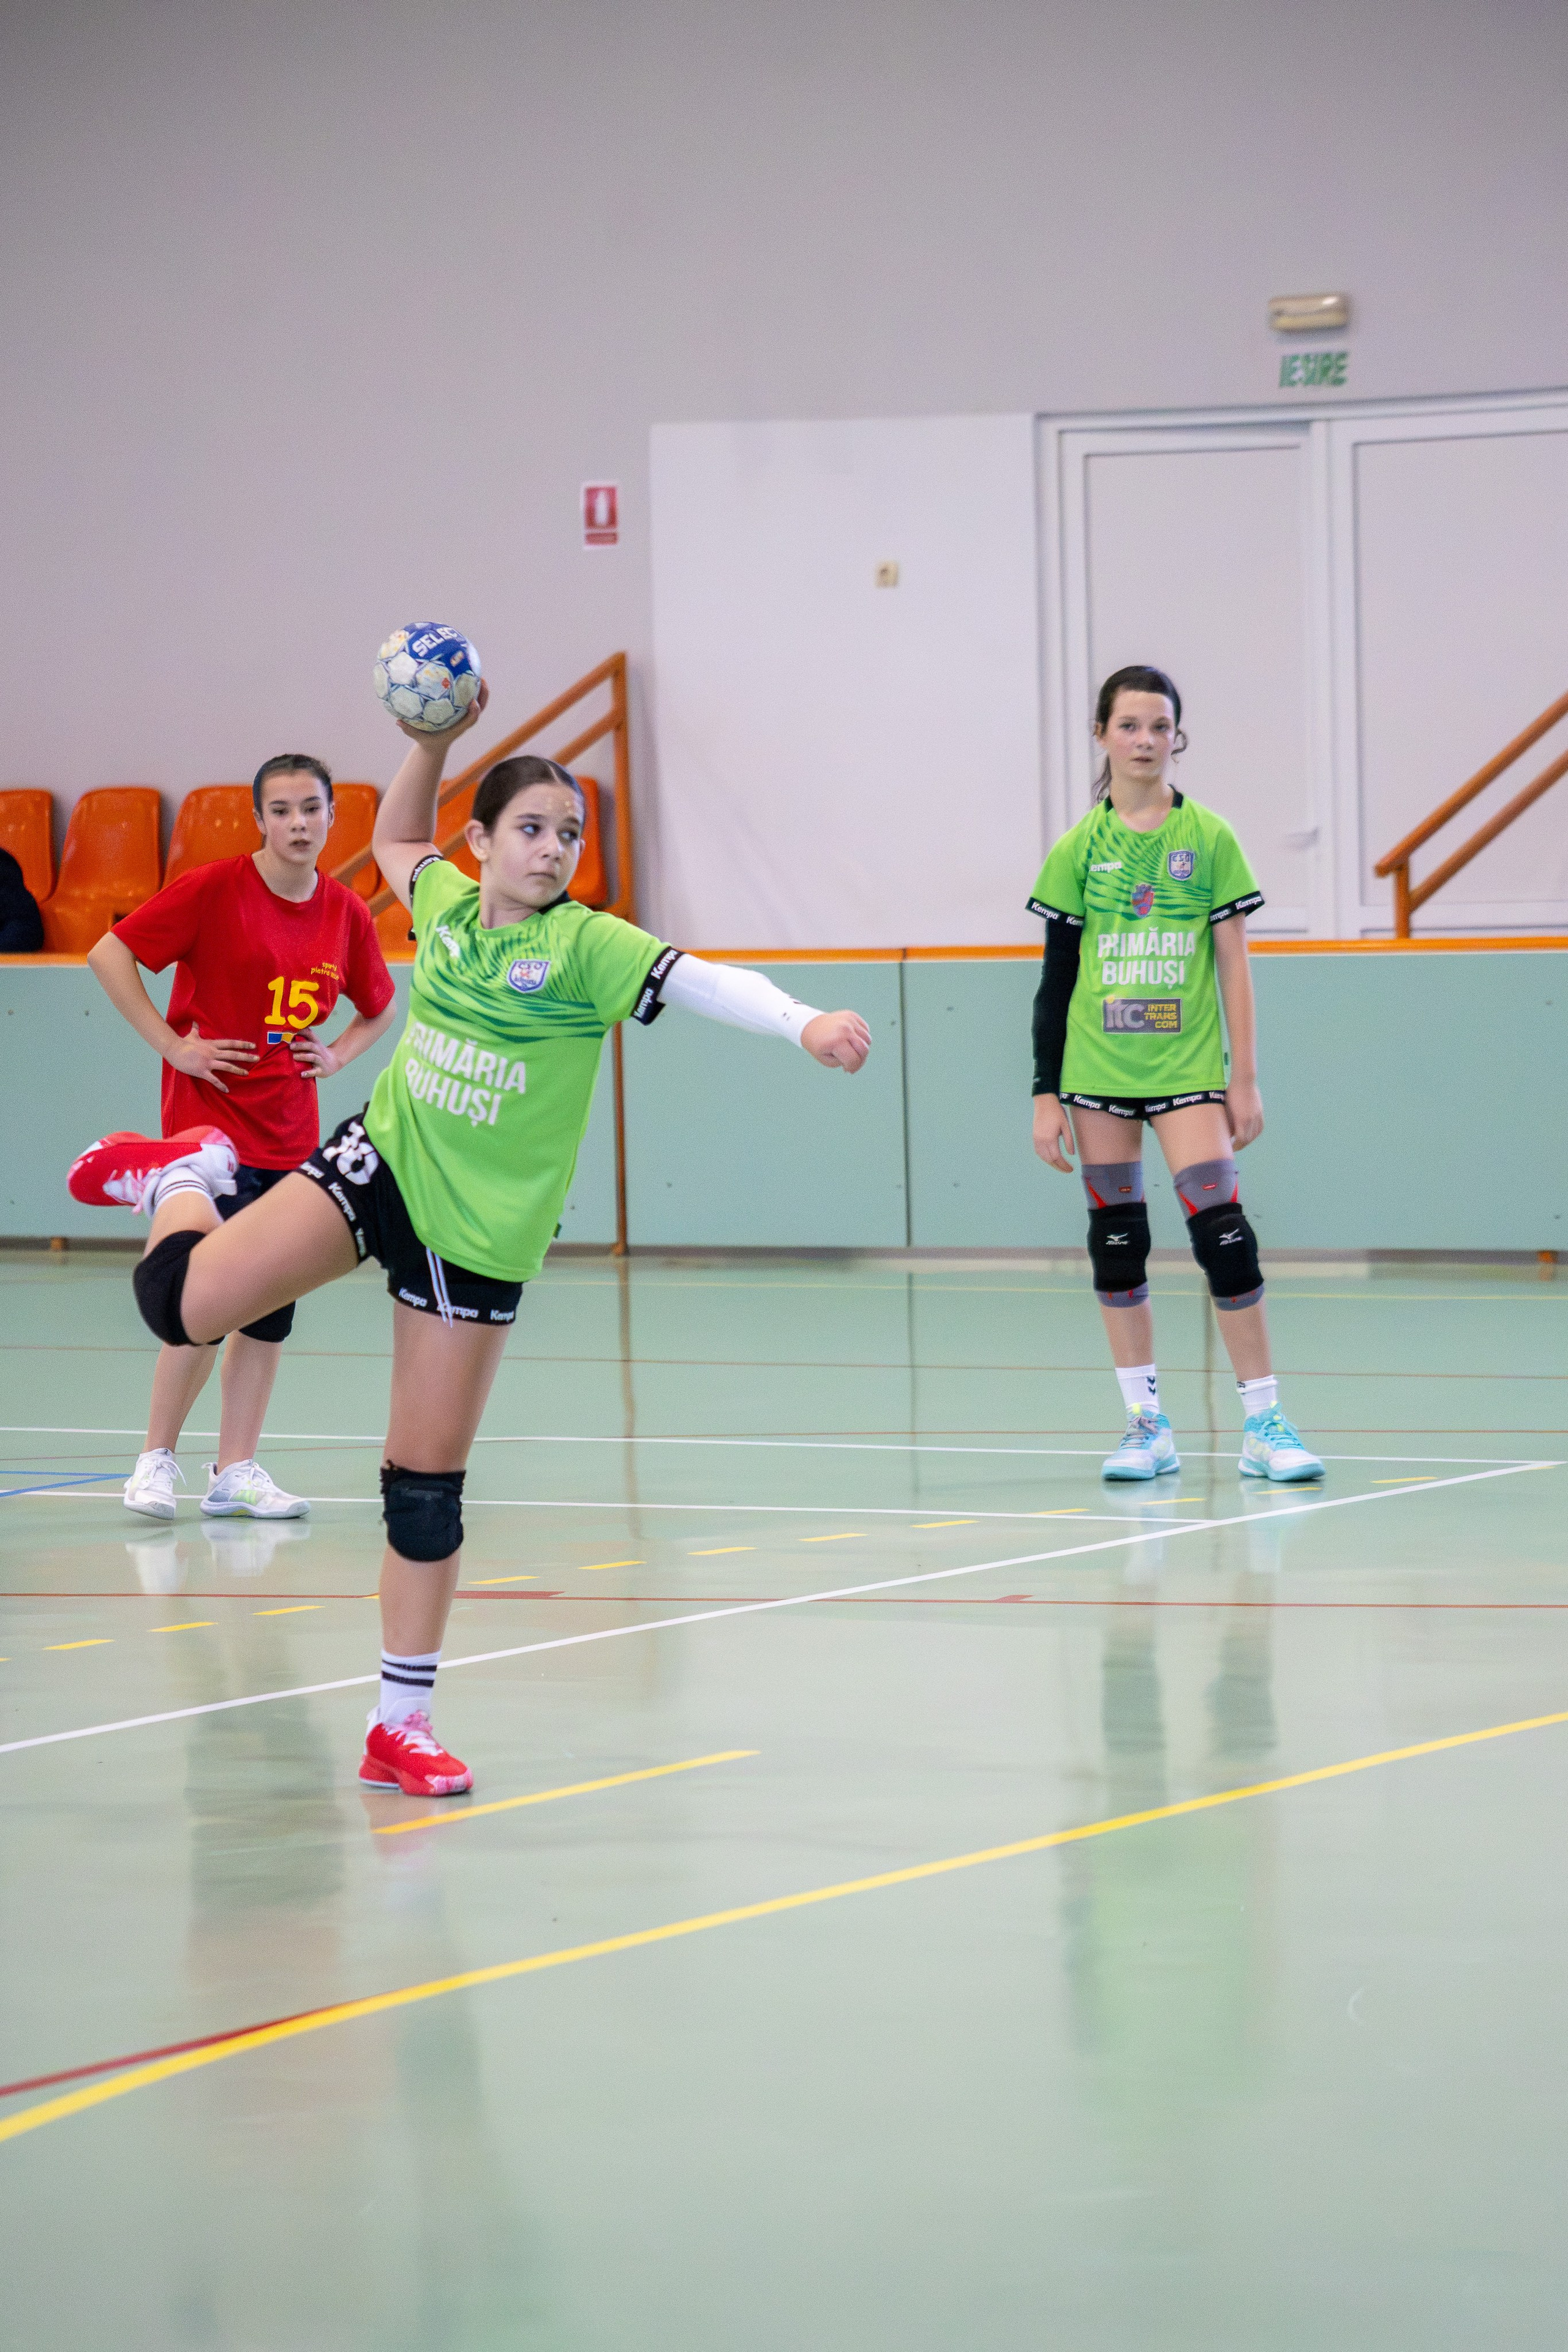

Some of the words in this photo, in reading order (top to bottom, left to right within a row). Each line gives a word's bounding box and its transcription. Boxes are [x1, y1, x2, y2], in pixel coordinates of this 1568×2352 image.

[412, 627, 461, 657] SELEC
[1090, 862, 1122, 873] empa
[1031, 902, 1060, 920] Kempa
[1066, 916, 1084, 928] Kem
[1098, 927, 1196, 957] PRIMĂRIA
[1102, 960, 1185, 990] BUHUȘI
[265, 976, 319, 1029] 15
[1073, 1095, 1101, 1109] Kempa
[1172, 1095, 1203, 1106] Kempa
[1109, 1104, 1135, 1117] Kempa
[399, 1287, 428, 1307] Kempa
